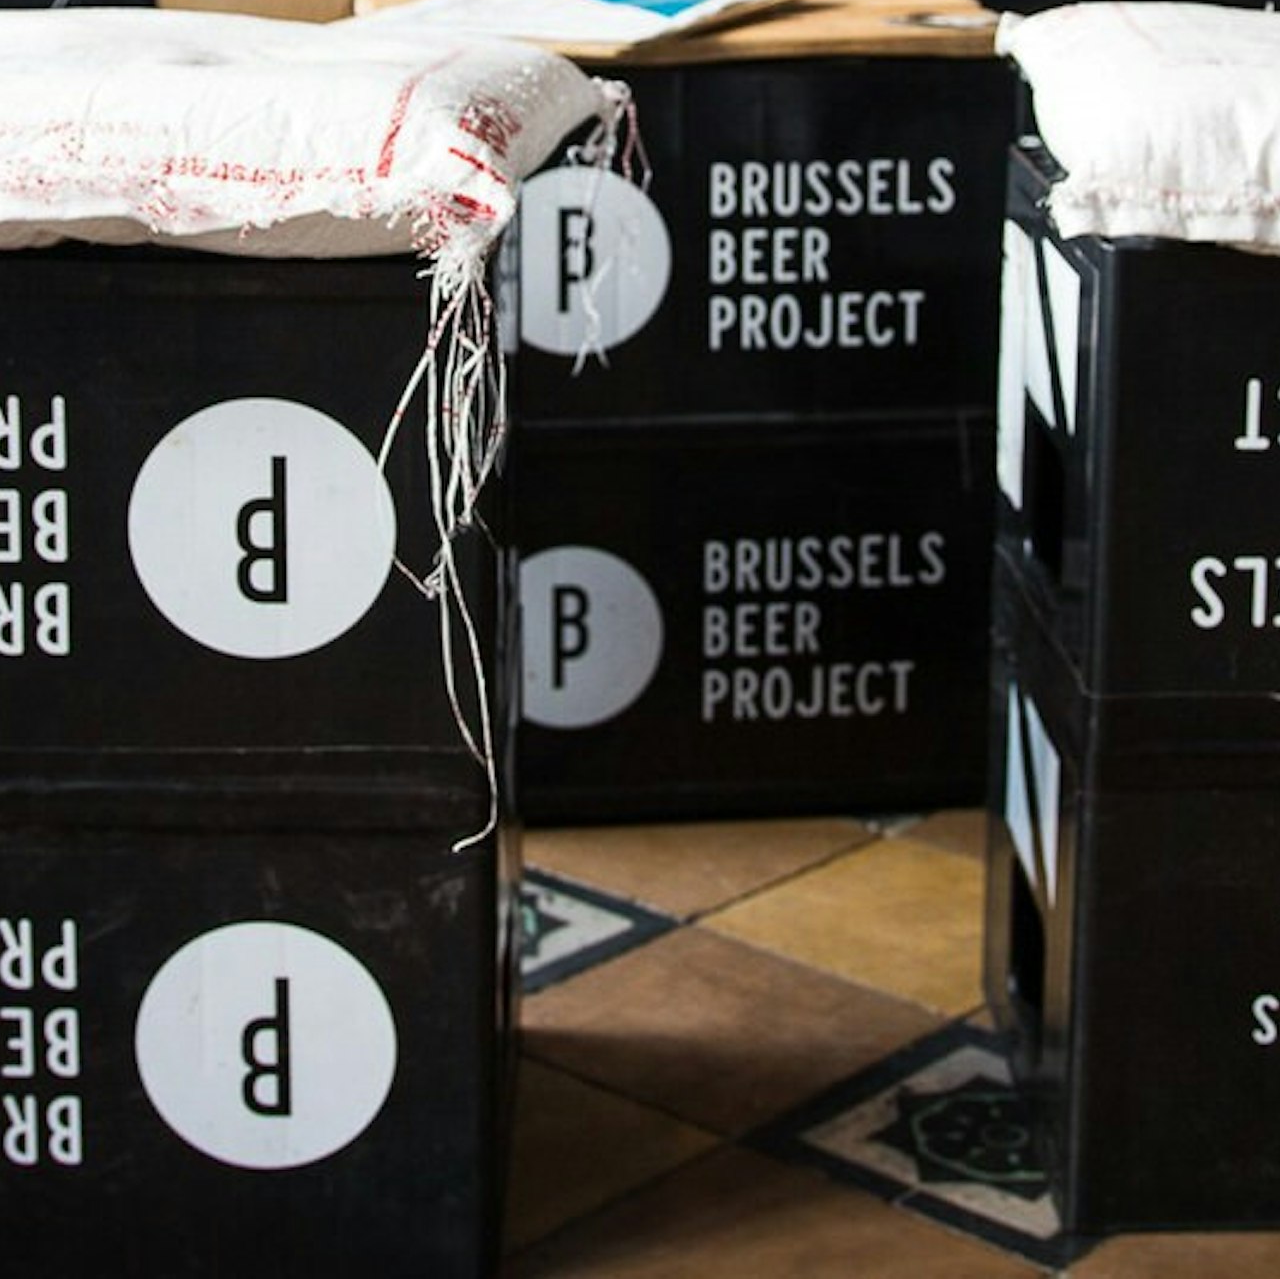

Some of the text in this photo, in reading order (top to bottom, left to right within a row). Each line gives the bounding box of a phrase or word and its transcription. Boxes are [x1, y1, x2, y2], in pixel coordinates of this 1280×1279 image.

[710, 158, 955, 218] BRUSSELS
[710, 227, 829, 284] BEER
[709, 290, 924, 350] PROJECT
[704, 532, 945, 593] BRUSSELS
[703, 601, 820, 658] BEER
[702, 661, 914, 721] PROJECT
